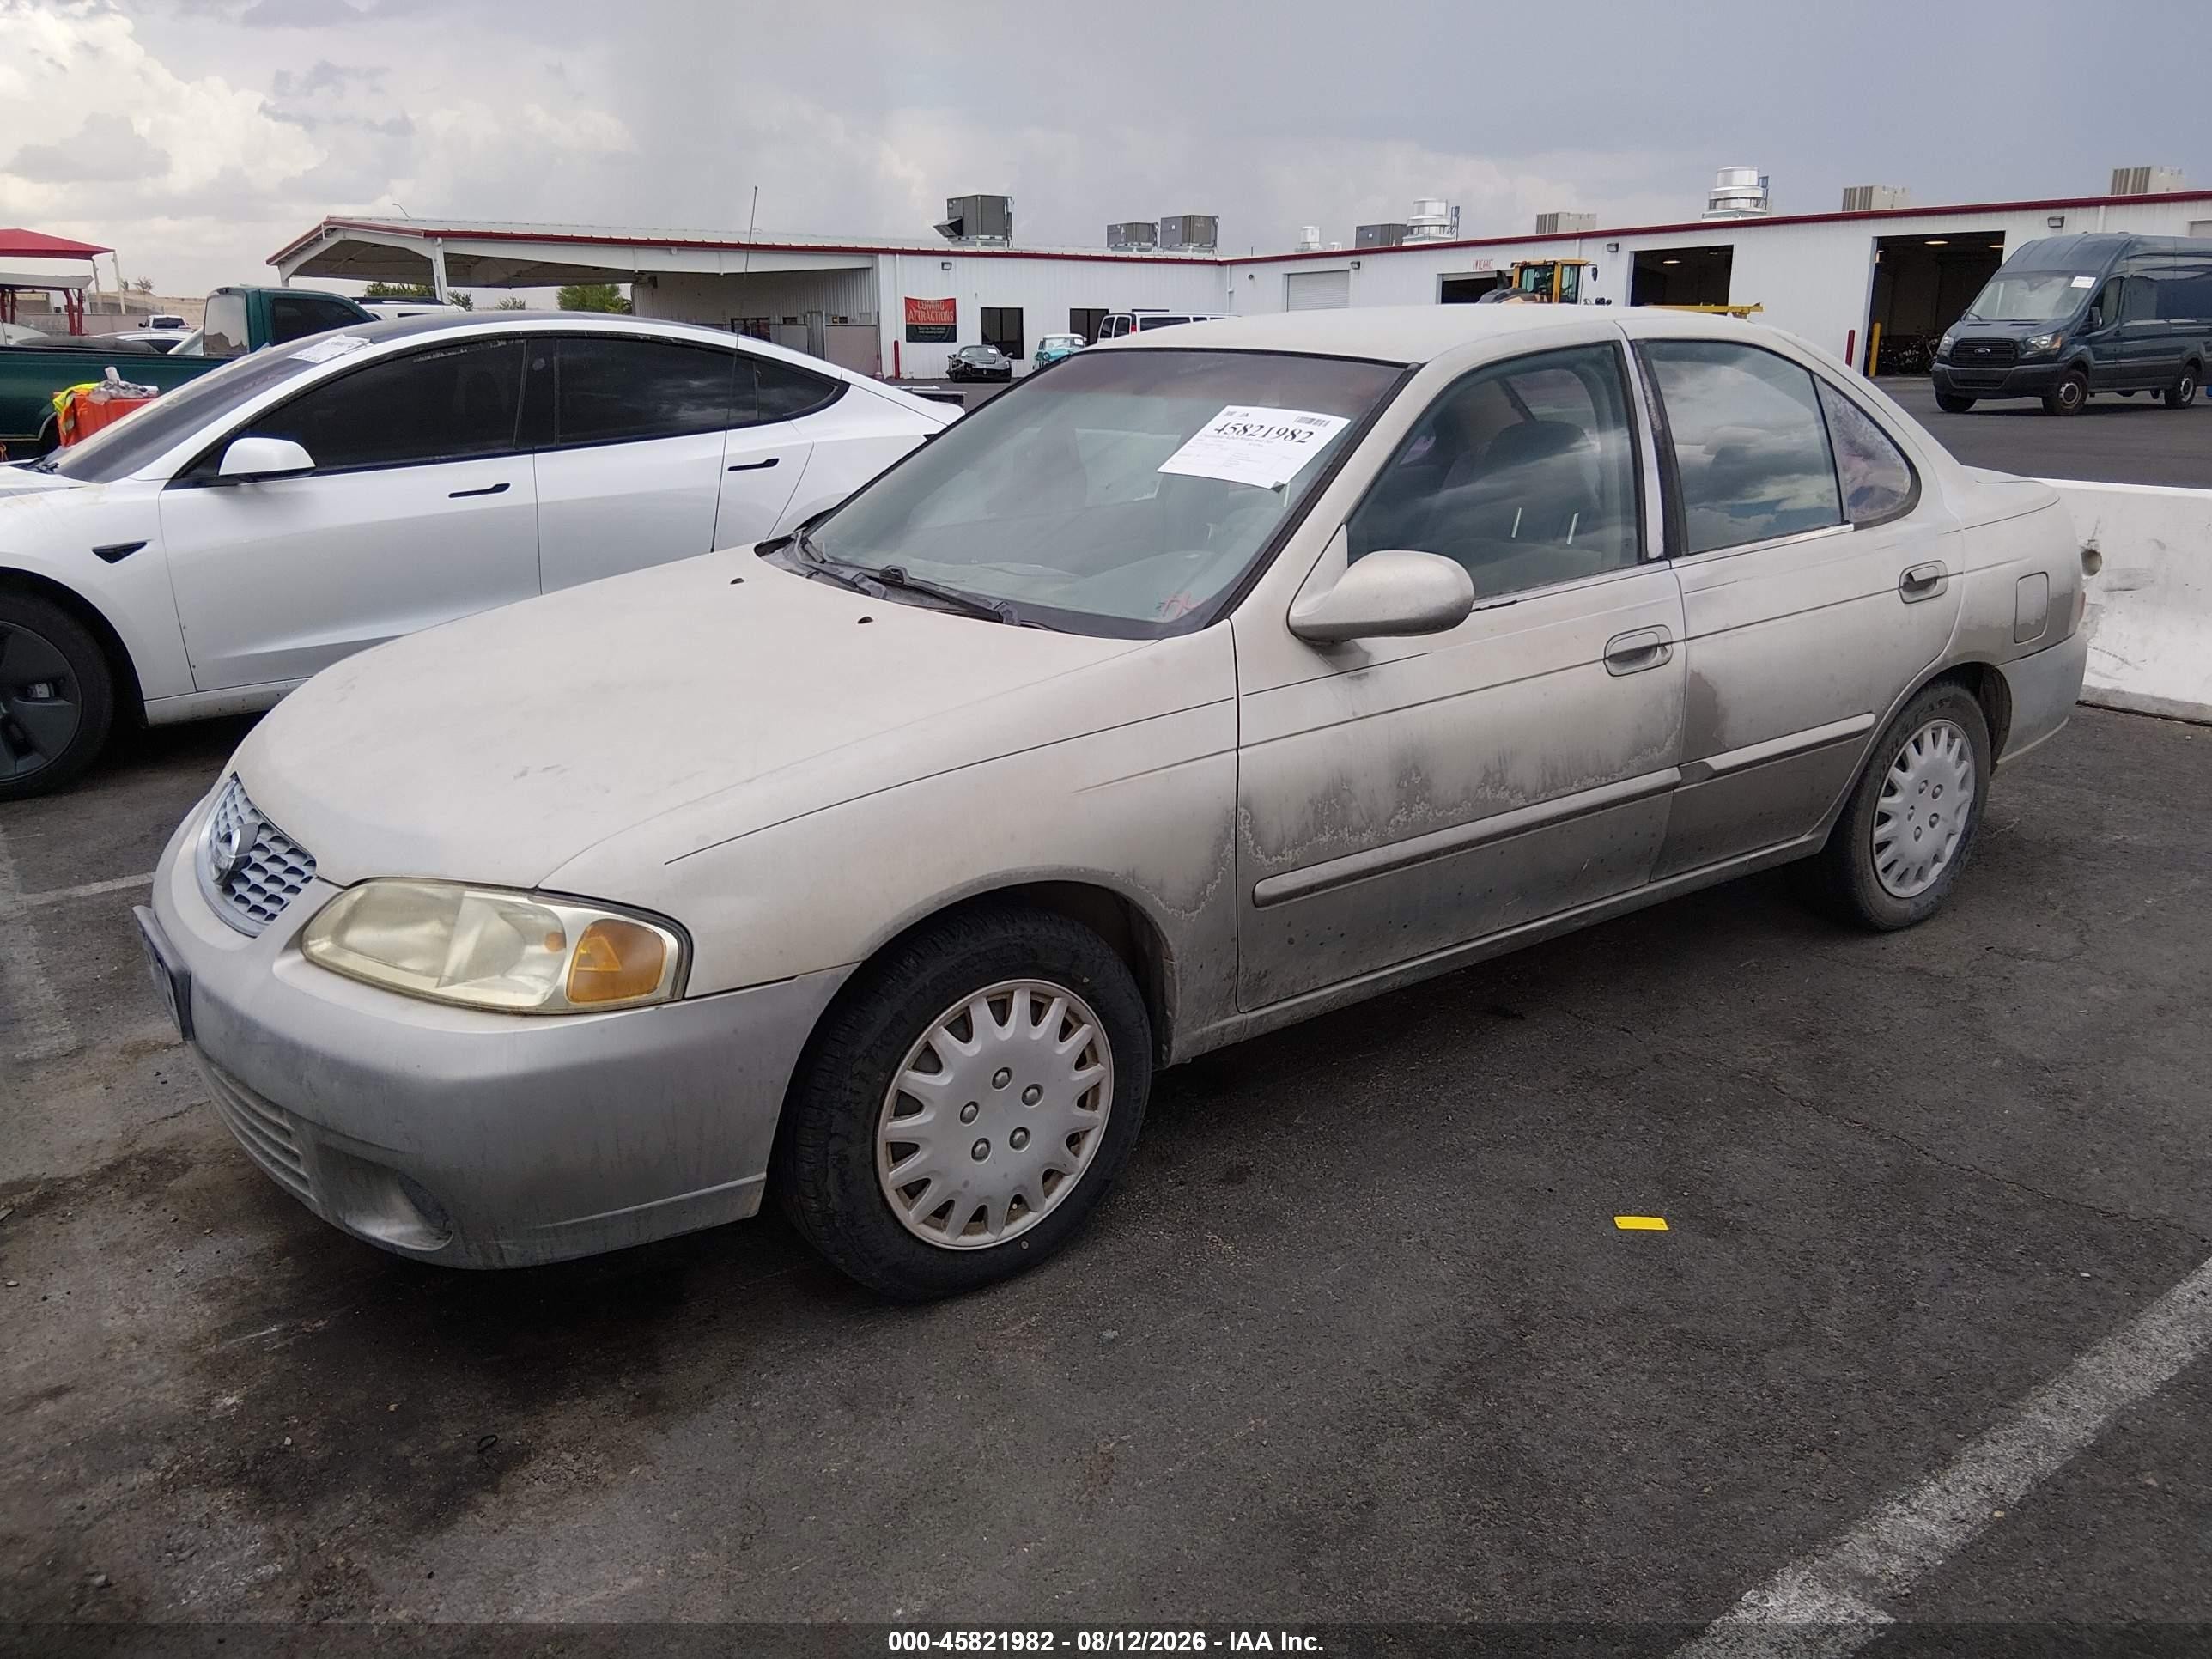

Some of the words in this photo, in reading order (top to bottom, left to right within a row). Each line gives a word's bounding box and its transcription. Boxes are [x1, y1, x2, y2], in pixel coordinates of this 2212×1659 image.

[917, 301, 945, 311] COMING
[908, 309, 954, 323] ATTRACTIONS
[1214, 422, 1315, 444] 45821982
